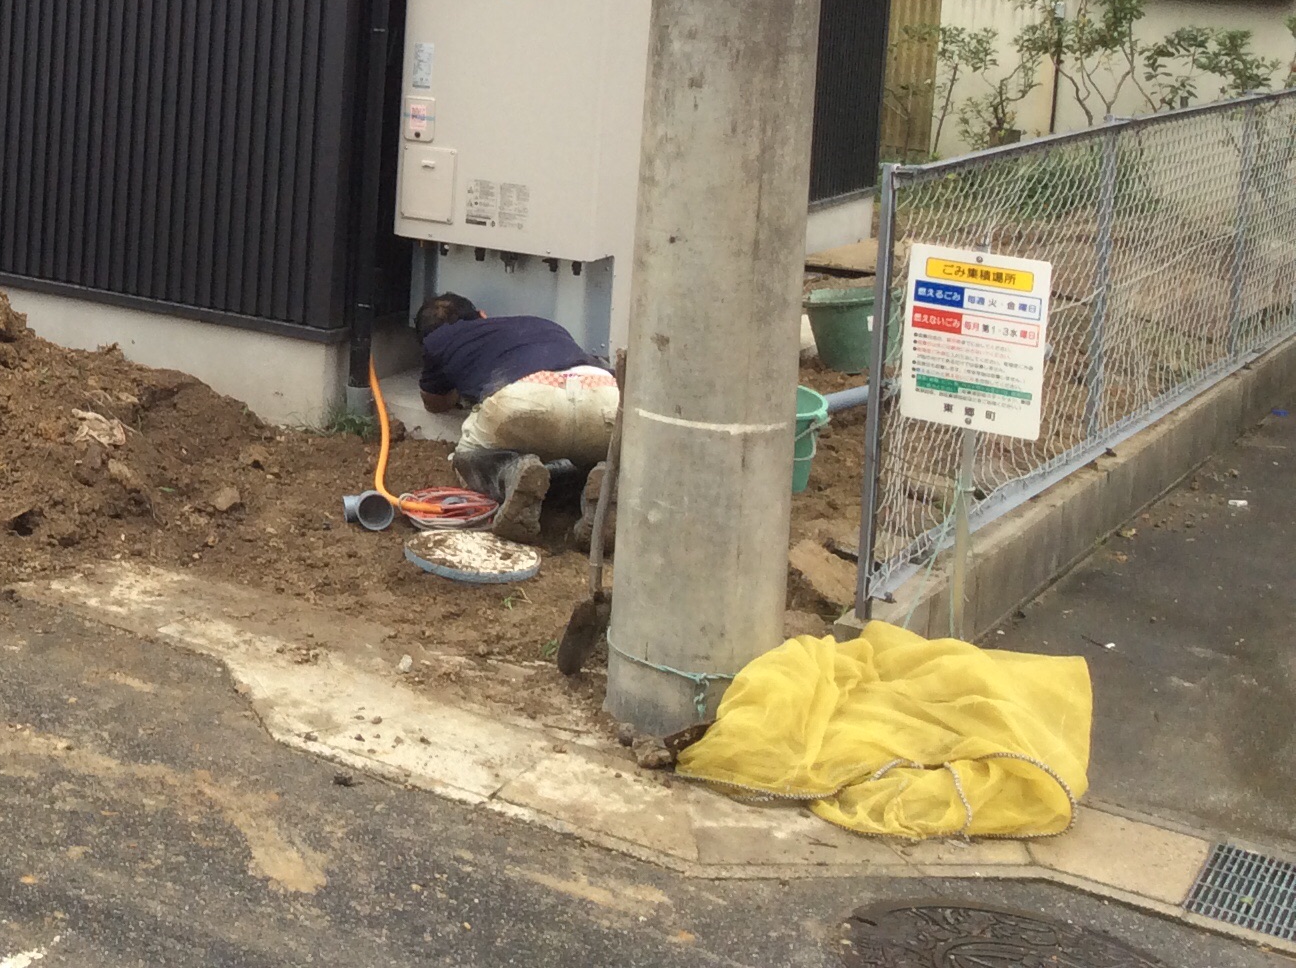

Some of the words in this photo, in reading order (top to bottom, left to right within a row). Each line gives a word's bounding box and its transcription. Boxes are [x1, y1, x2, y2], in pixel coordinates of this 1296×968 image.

[942, 264, 1016, 285] ごみ集積場所
[917, 287, 961, 302] 燃えるごみ
[913, 313, 961, 329] 燃えないごみ
